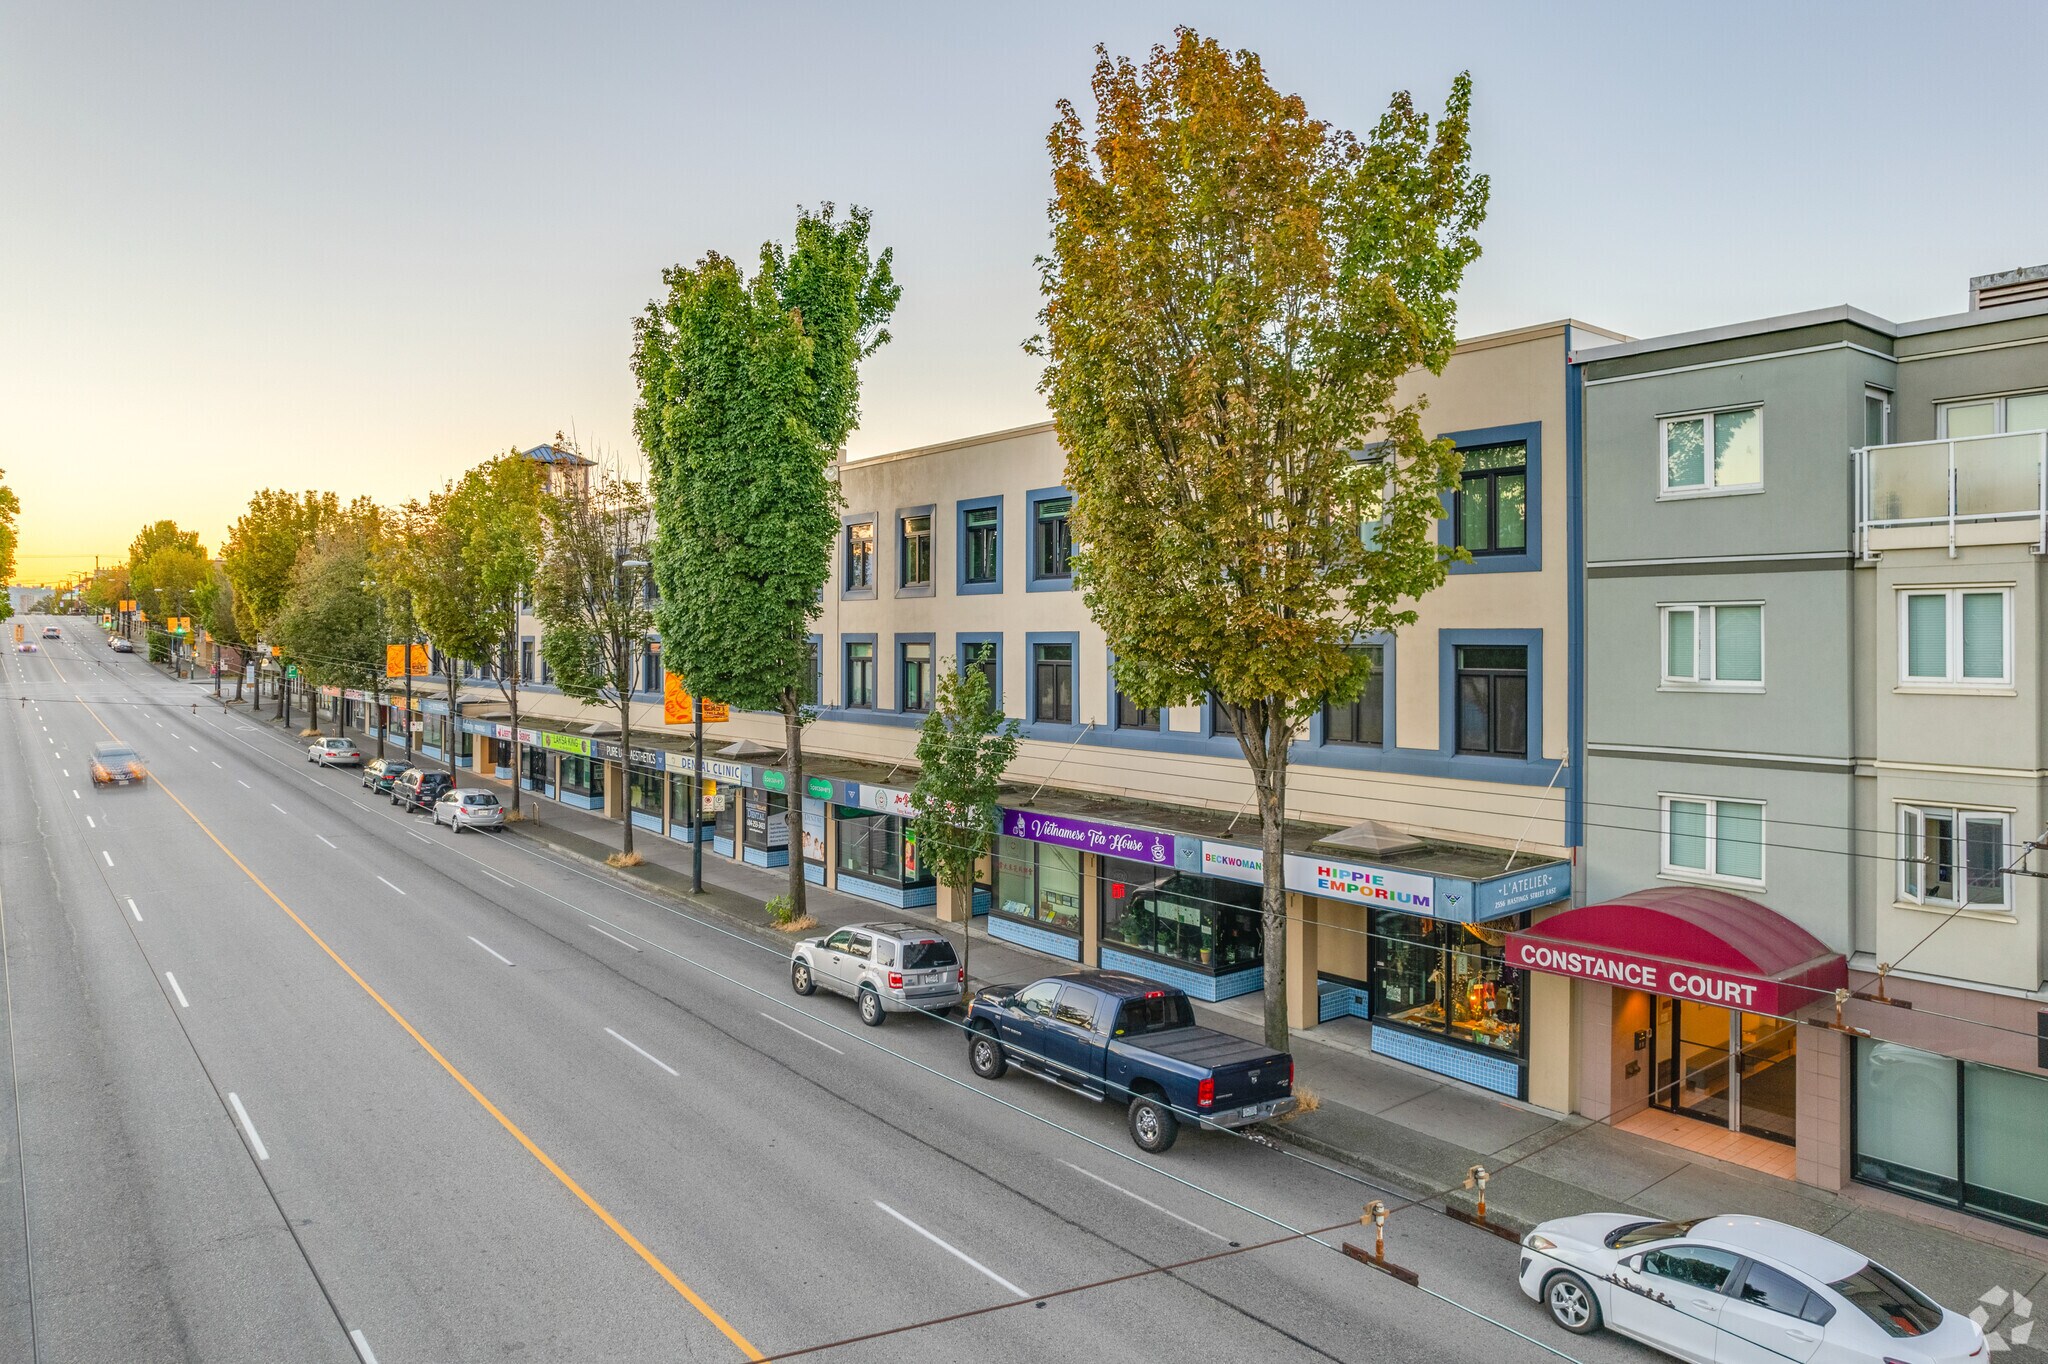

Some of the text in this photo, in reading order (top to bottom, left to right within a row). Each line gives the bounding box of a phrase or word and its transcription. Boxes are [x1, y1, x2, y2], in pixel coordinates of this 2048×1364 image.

[553, 733, 579, 748] LAKSA KING
[606, 745, 618, 758] PURE
[630, 749, 656, 765] AESTHETICS
[681, 757, 740, 779] DENAL CLINIC
[1031, 819, 1144, 852] Vietnamese Tea House
[1318, 866, 1384, 886] HIPPIE
[1503, 874, 1549, 896] L'ATELIER
[1318, 878, 1430, 907] EMPORIUM
[1507, 893, 1529, 906] HASTINGS
[1529, 889, 1545, 900] STREET
[1545, 887, 1557, 896] EAST
[1521, 944, 1758, 1006] CONSTANCE COURT
